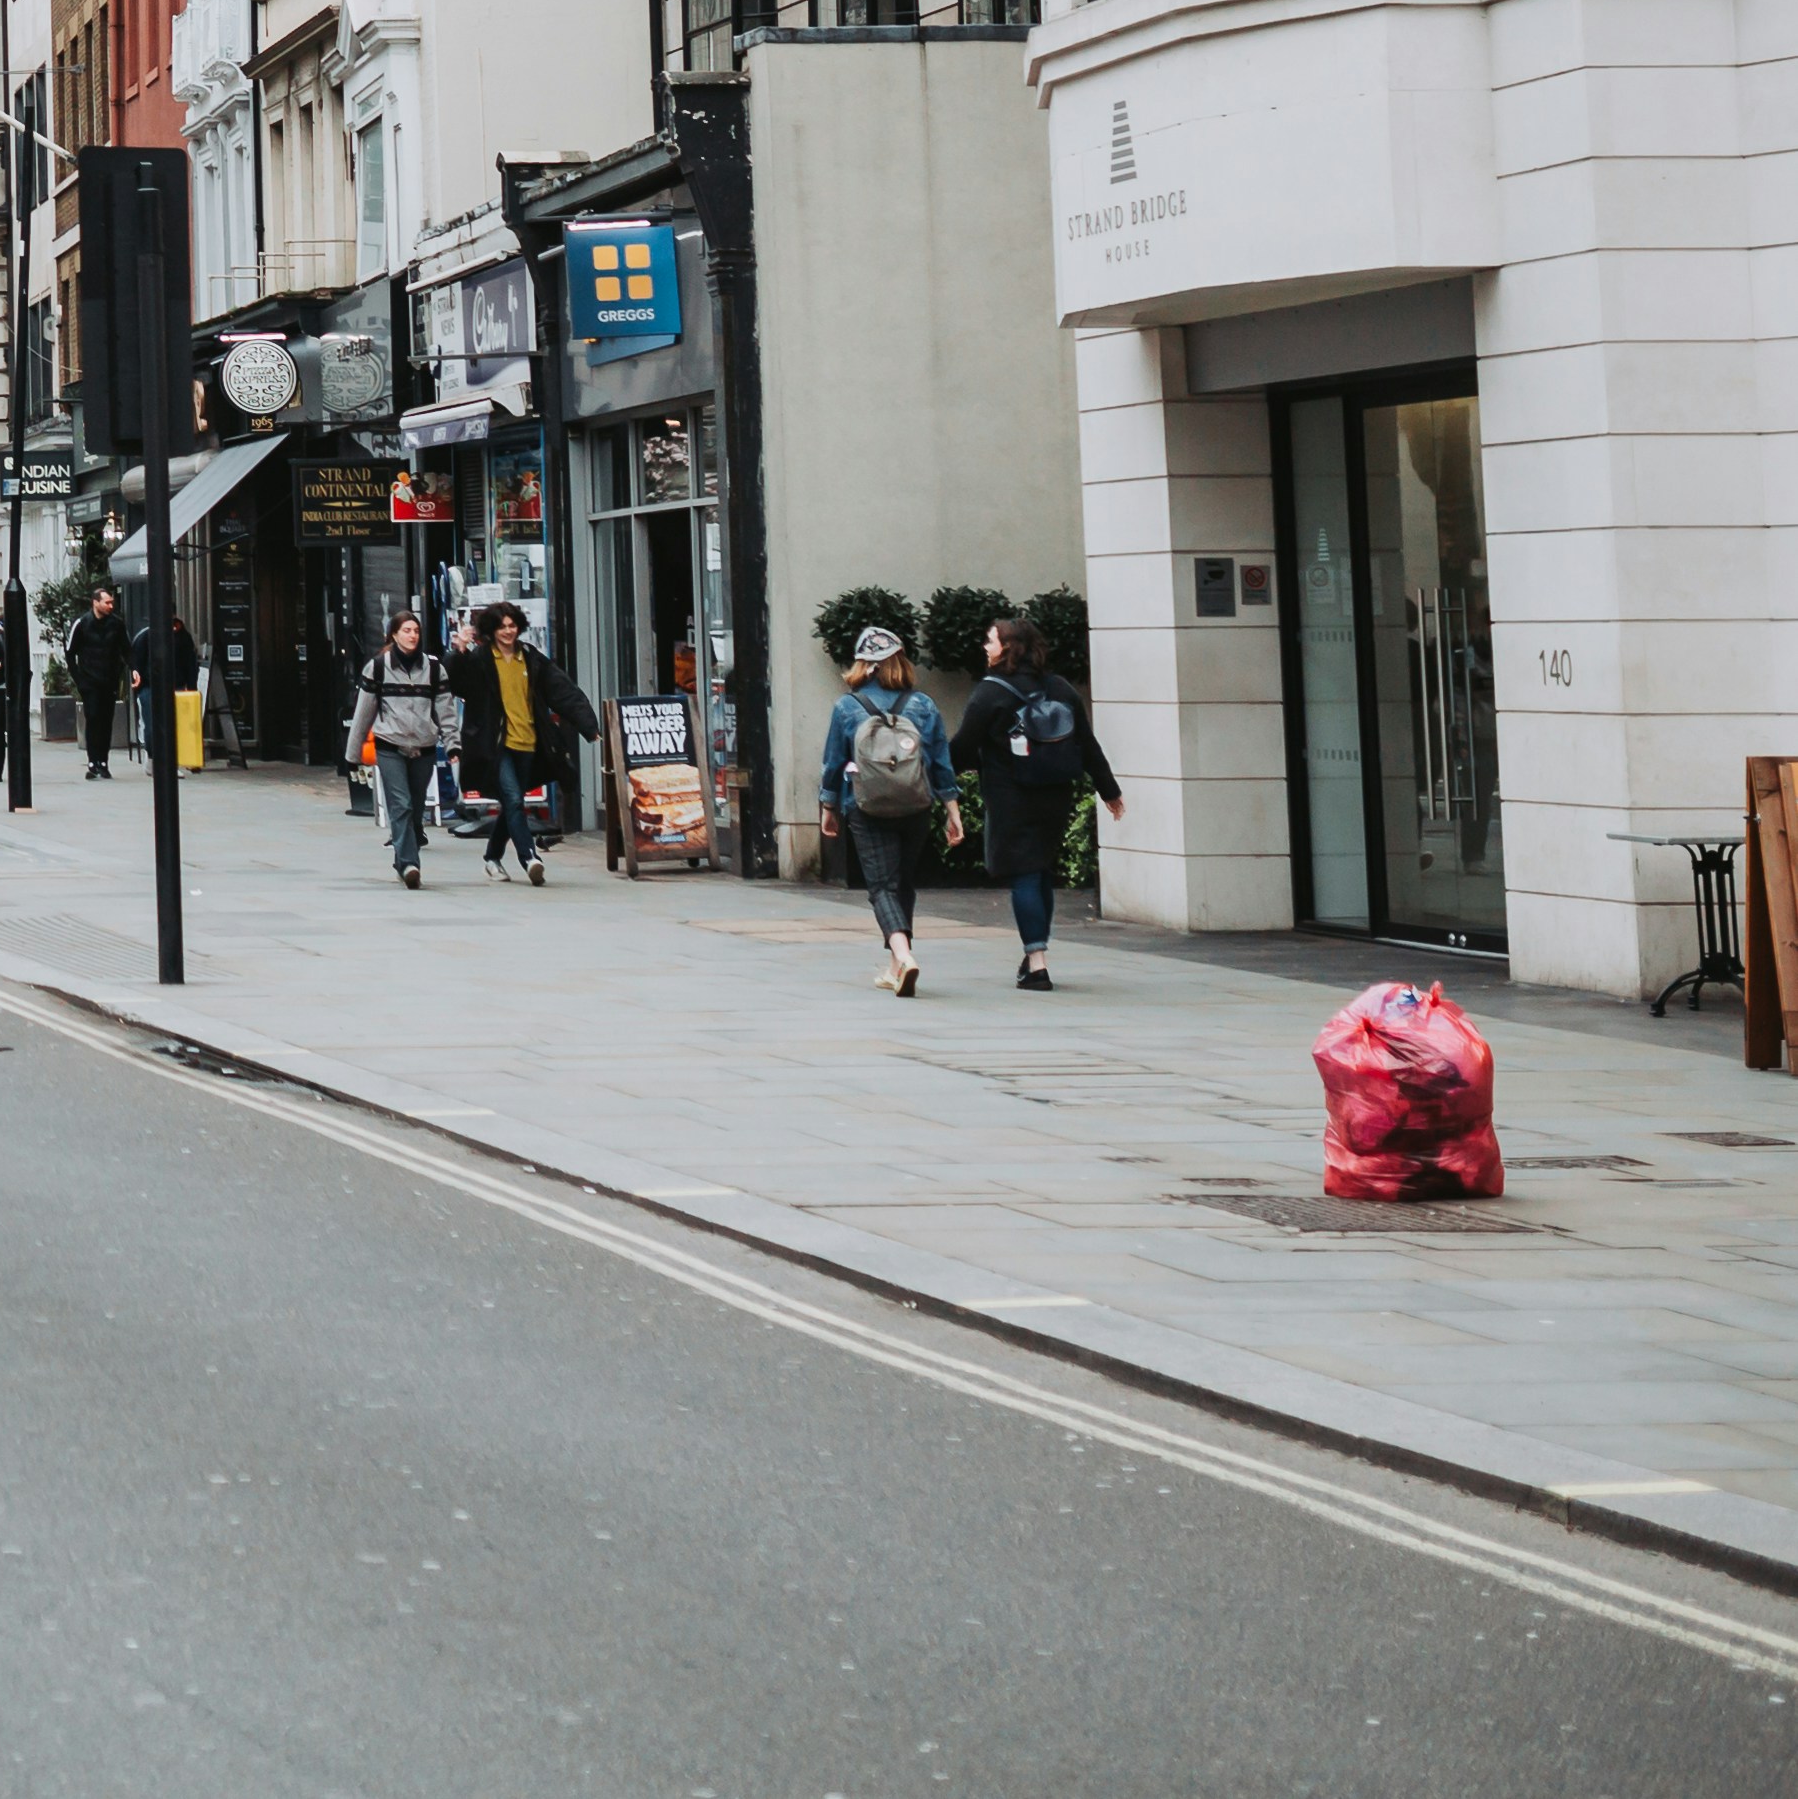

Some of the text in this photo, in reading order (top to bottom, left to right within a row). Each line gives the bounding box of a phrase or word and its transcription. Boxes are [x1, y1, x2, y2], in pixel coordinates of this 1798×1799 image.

[1068, 190, 1187, 241] STRAND BRIDGE
[1105, 239, 1150, 264] HOUSE
[597, 308, 656, 323] GREGGS
[243, 366, 276, 376] PIZZA
[233, 374, 288, 385] EXPRESS
[251, 416, 274, 429] 1965
[22, 464, 71, 478] NDIAN
[318, 467, 372, 482] STRAND
[304, 483, 388, 498] CONTINENTAL
[325, 525, 344, 537] 2nd
[1539, 649, 1572, 687] 140
[621, 702, 684, 718] MELTS YOUR
[623, 714, 686, 735] HUNGER
[626, 731, 687, 756] AWAY
